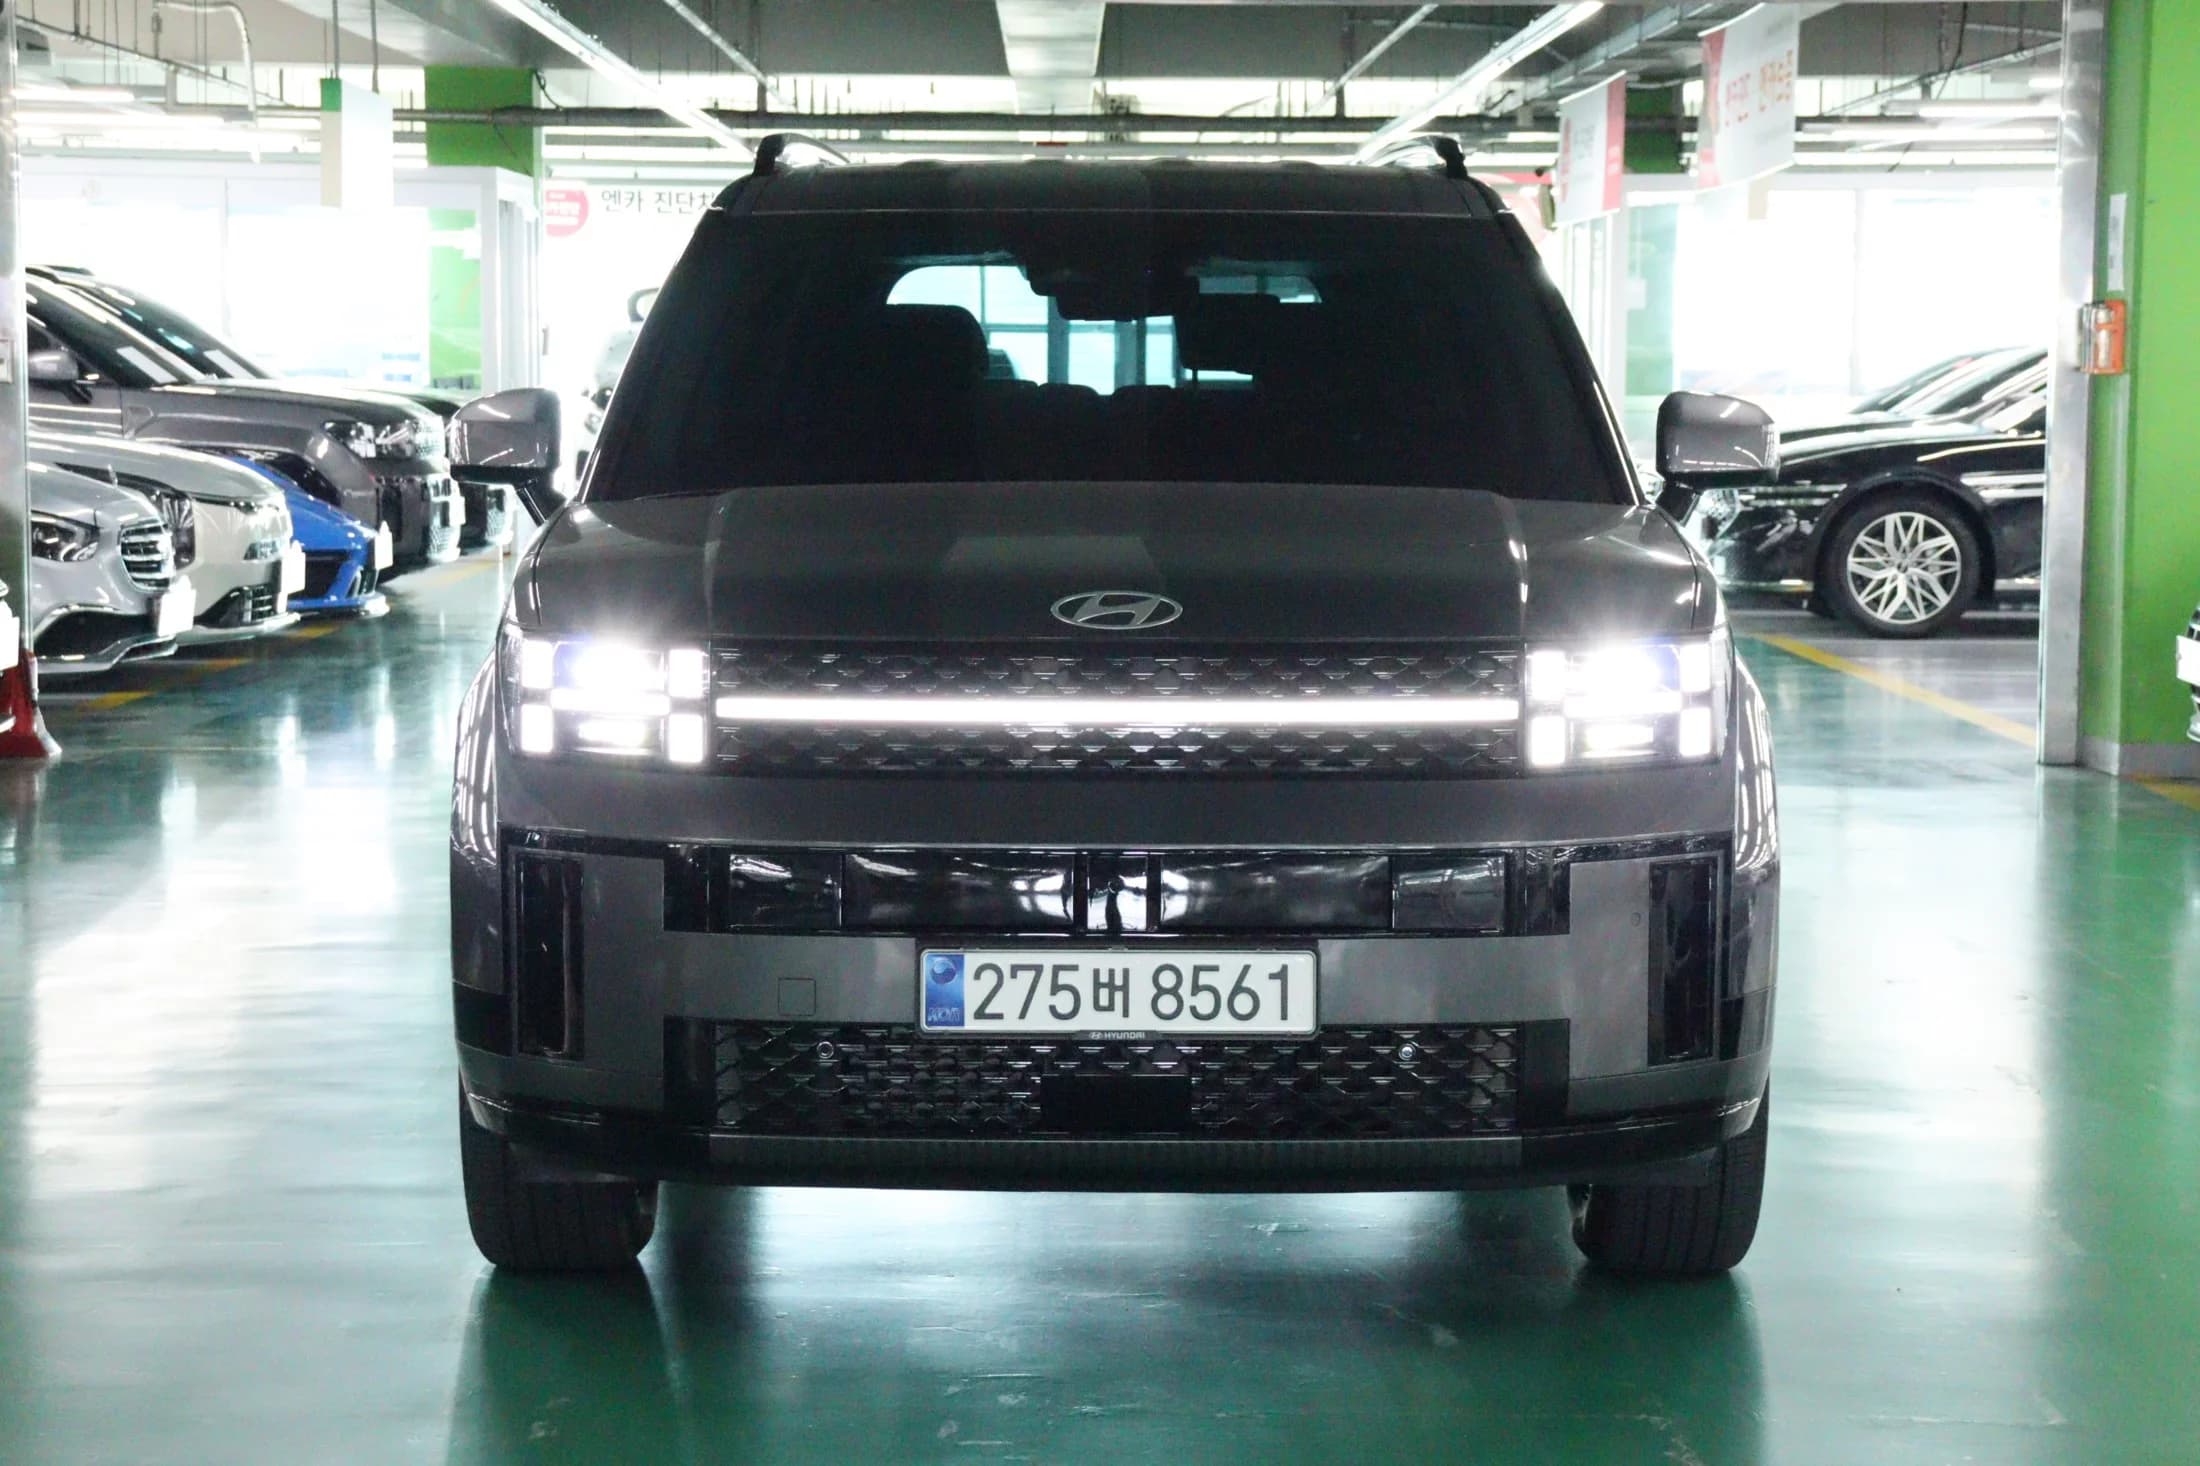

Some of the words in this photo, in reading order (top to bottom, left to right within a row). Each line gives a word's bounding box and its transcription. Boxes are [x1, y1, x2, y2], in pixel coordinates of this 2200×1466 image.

[601, 189, 644, 213] 엔카
[973, 963, 1130, 1021] 275버
[1150, 963, 1289, 1021] 8561
[1103, 1031, 1145, 1040] HYUNDAI
